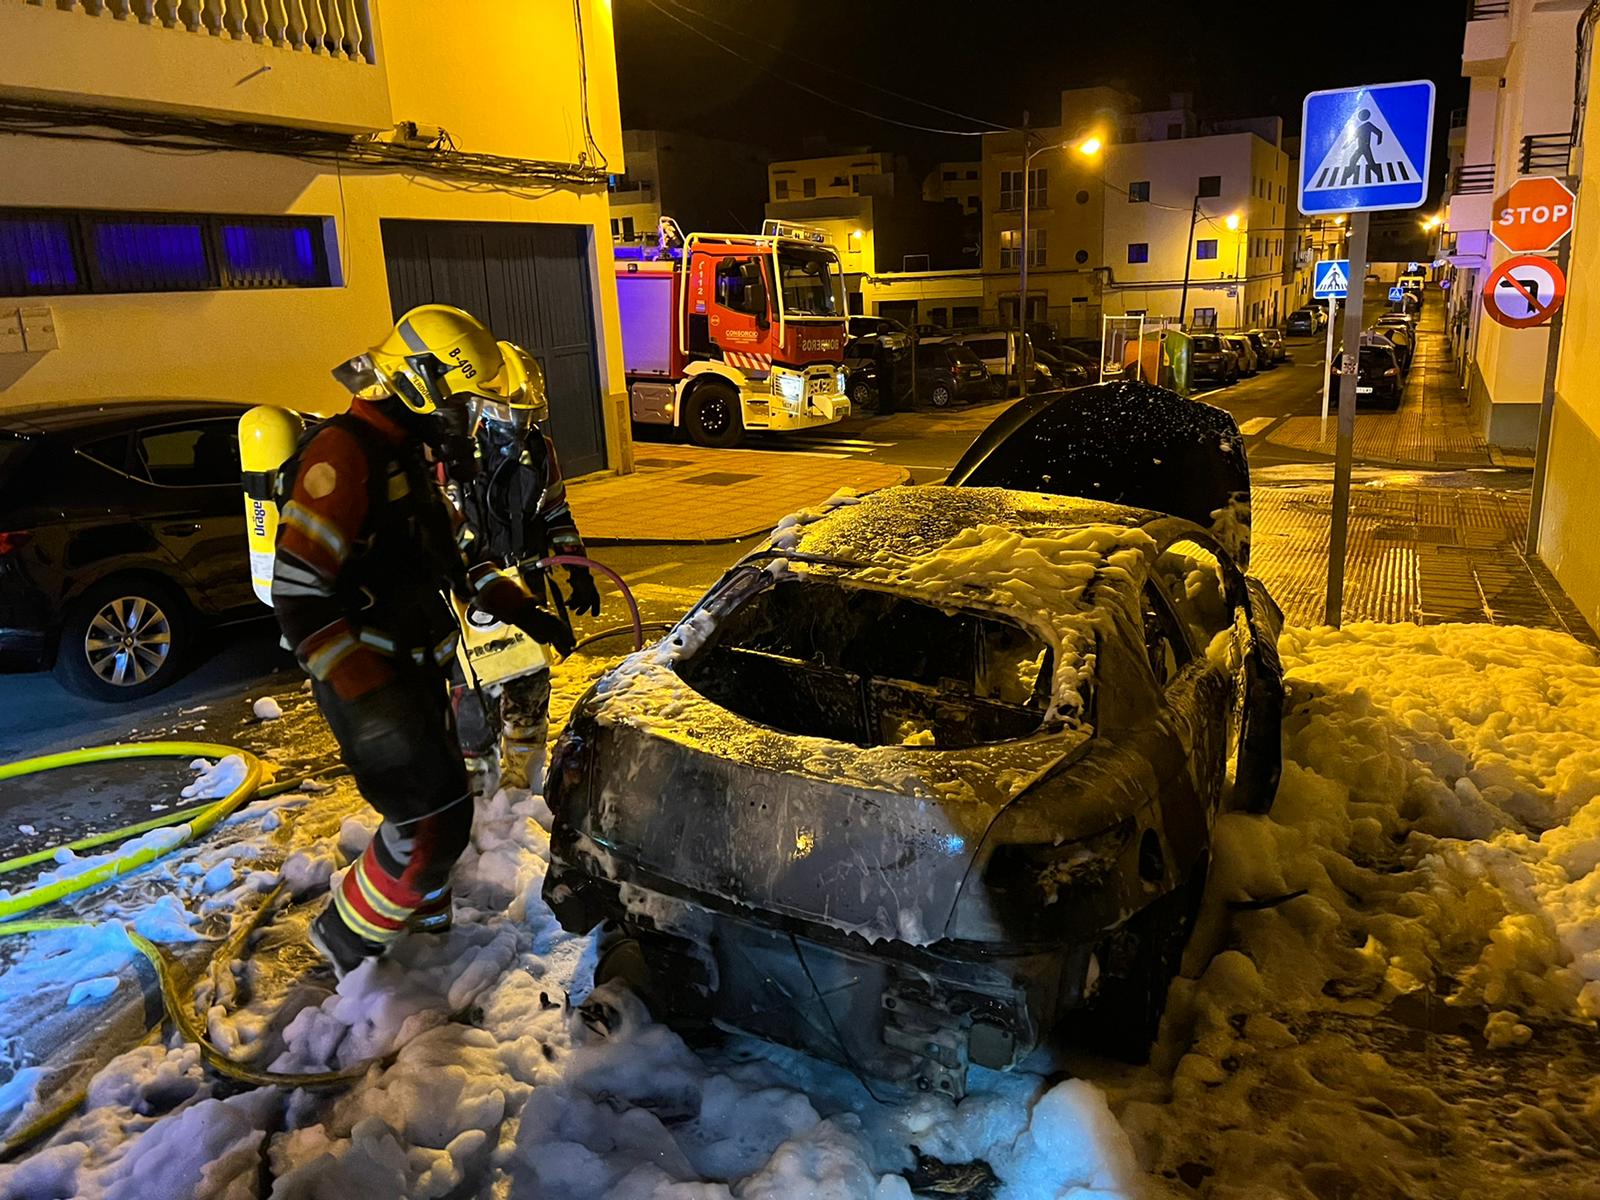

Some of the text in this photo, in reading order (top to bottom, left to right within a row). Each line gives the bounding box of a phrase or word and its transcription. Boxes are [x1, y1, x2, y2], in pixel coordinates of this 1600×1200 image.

[1498, 204, 1568, 226] STOP
[725, 329, 759, 338] CONSORCIO
[448, 347, 477, 379] B-409
